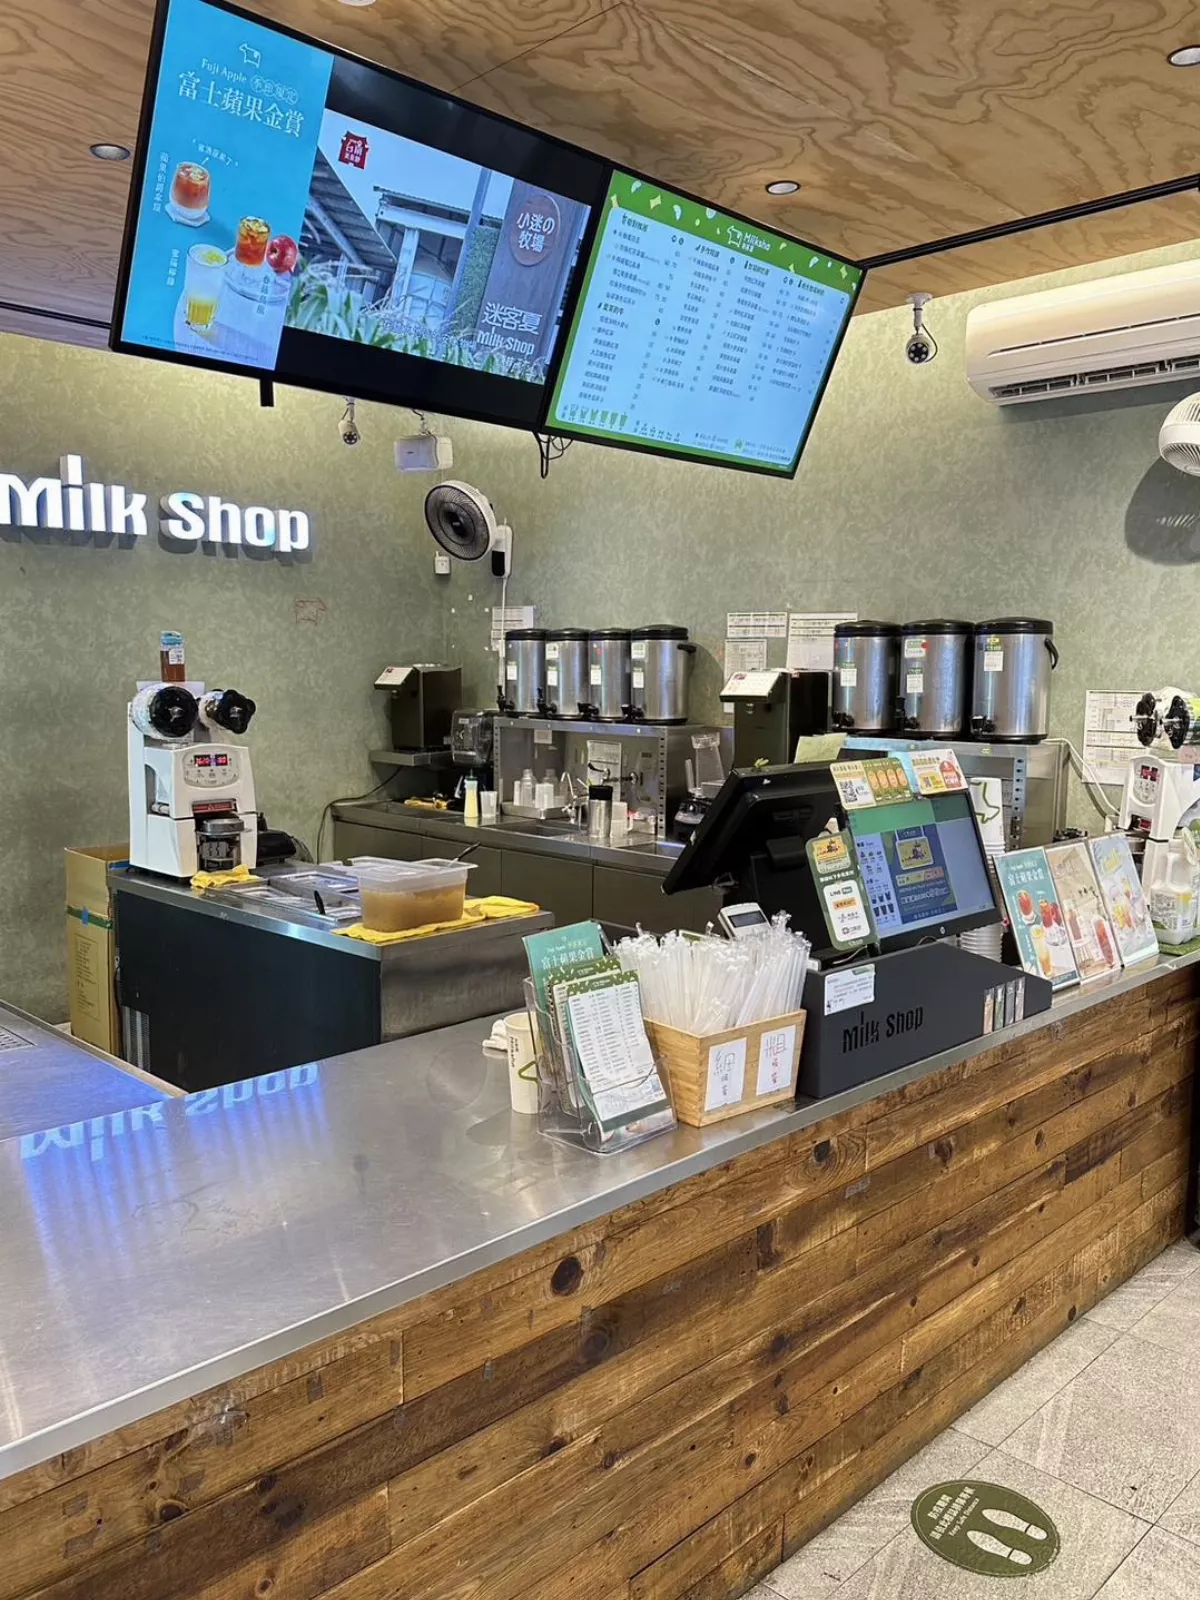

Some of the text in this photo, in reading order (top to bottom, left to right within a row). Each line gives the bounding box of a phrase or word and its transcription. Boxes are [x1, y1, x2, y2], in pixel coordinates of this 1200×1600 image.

[201, 58, 247, 83] Fuji Apple
[178, 70, 305, 138] 富士蘋果金賞
[516, 212, 556, 235] 小迷の
[518, 230, 546, 253] 牧場
[743, 232, 771, 252] Milksha
[481, 301, 542, 335] 迷客夏
[160, 492, 310, 552] Shop
[842, 1005, 924, 1053] Milk Shop
